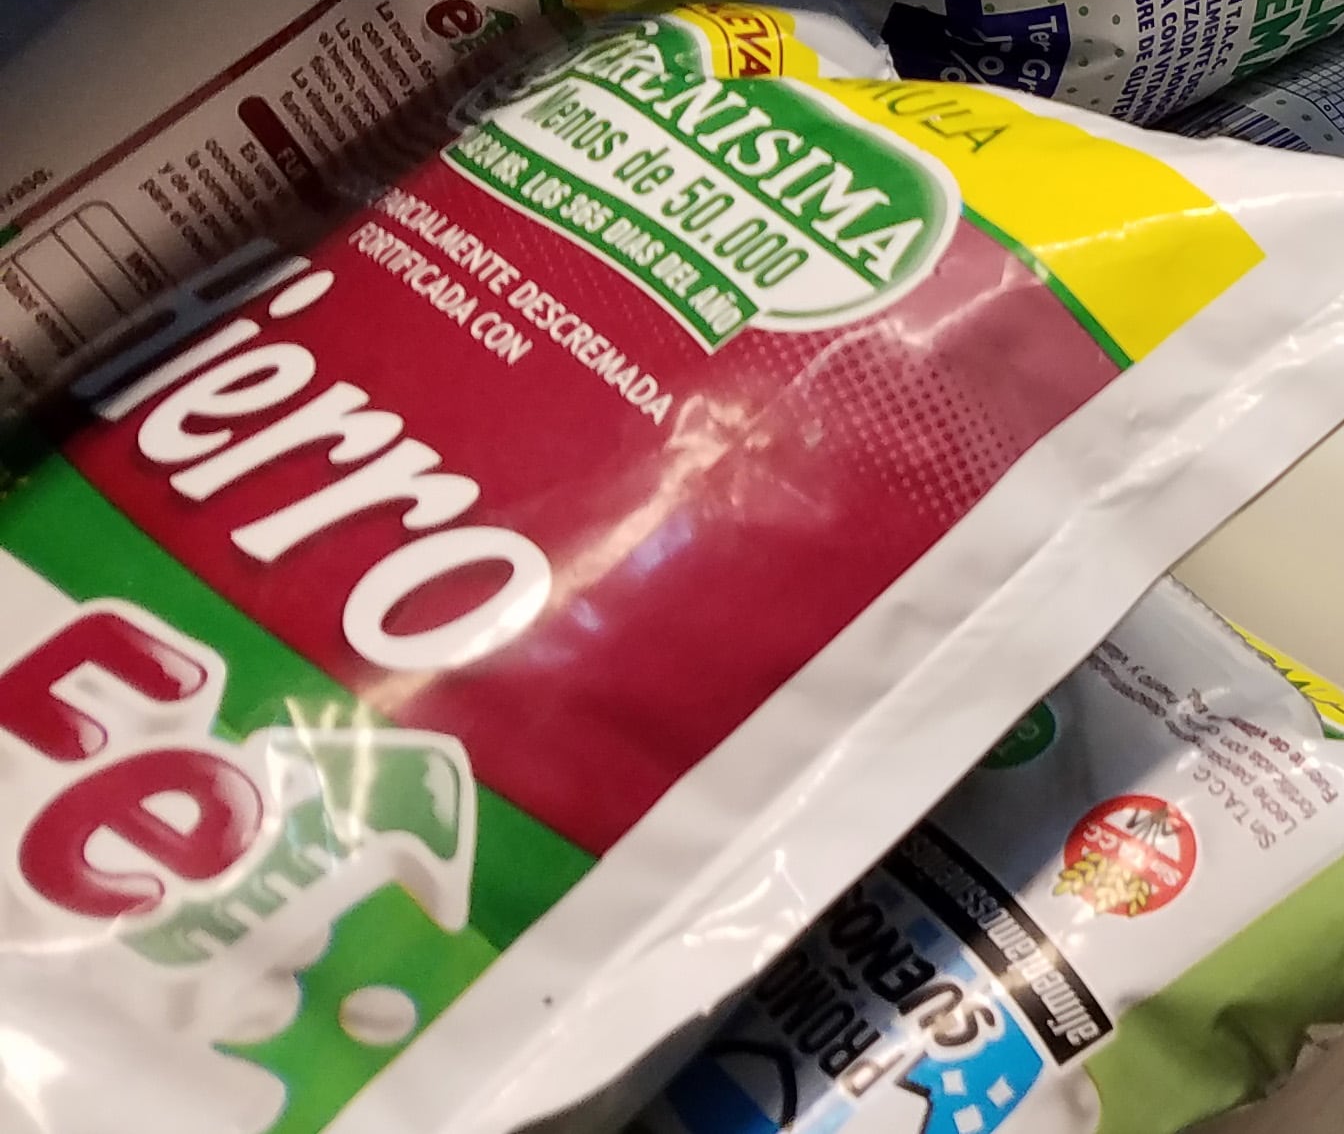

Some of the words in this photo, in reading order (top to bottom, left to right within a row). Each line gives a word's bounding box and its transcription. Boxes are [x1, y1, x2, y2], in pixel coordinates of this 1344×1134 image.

[1137, 37, 1154, 63] DE
[1159, 11, 1178, 58] CON
[521, 171, 560, 212] LOS
[560, 193, 606, 239] 365
[658, 249, 701, 298] DEL
[696, 274, 748, 338] AÑO
[611, 146, 670, 196] de
[661, 174, 809, 290] 50.000
[347, 221, 470, 327] FORTIFICADA
[468, 306, 534, 368] CON
[506, 277, 676, 427] DESCREMADA
